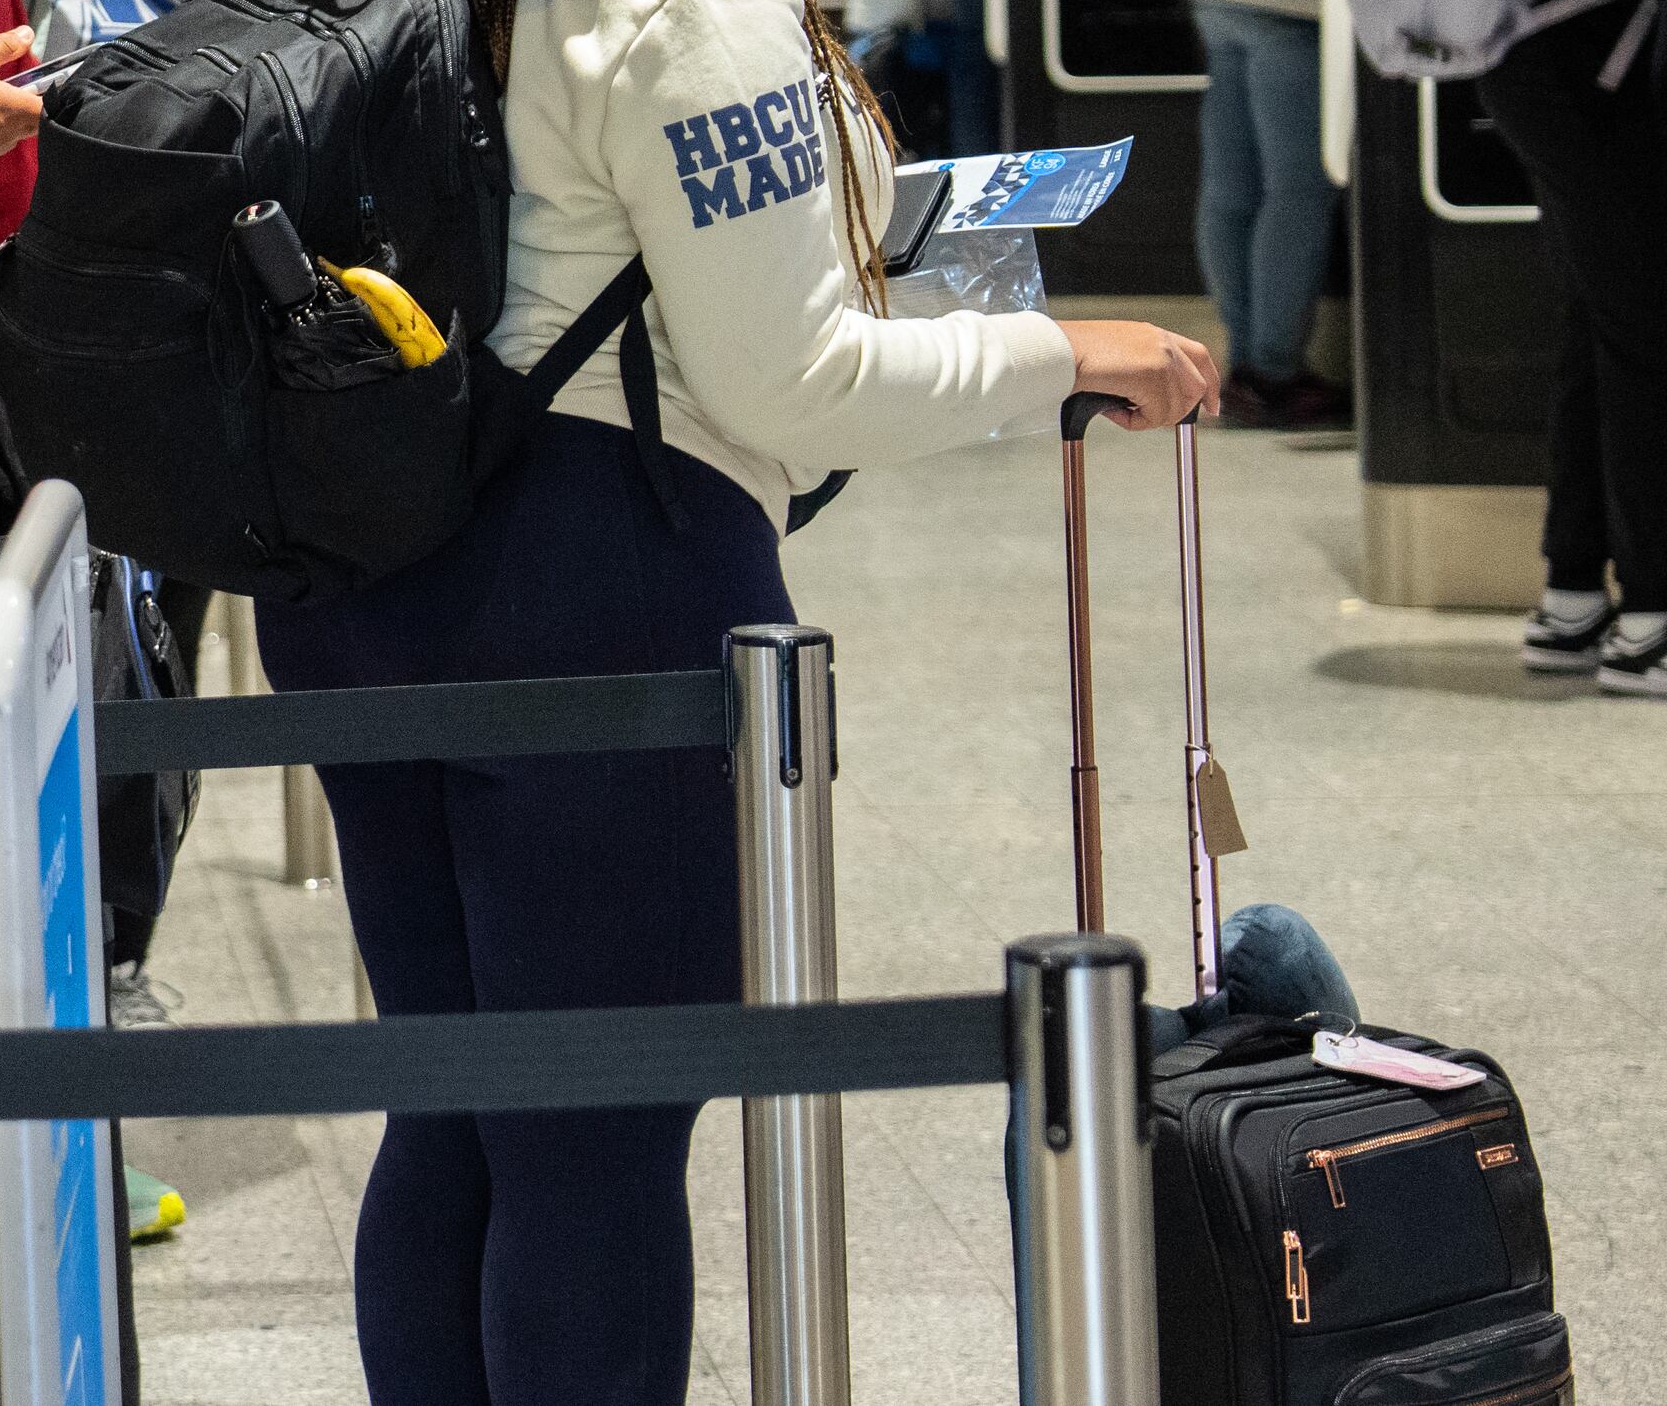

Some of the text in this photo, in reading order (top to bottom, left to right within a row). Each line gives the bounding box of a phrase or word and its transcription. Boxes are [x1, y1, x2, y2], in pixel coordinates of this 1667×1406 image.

[663, 79, 816, 178] HBCU
[1029, 158, 1044, 170] KF
[1043, 158, 1060, 169] 94
[680, 133, 825, 229] MADE
[1087, 181, 1101, 198] KOREA
